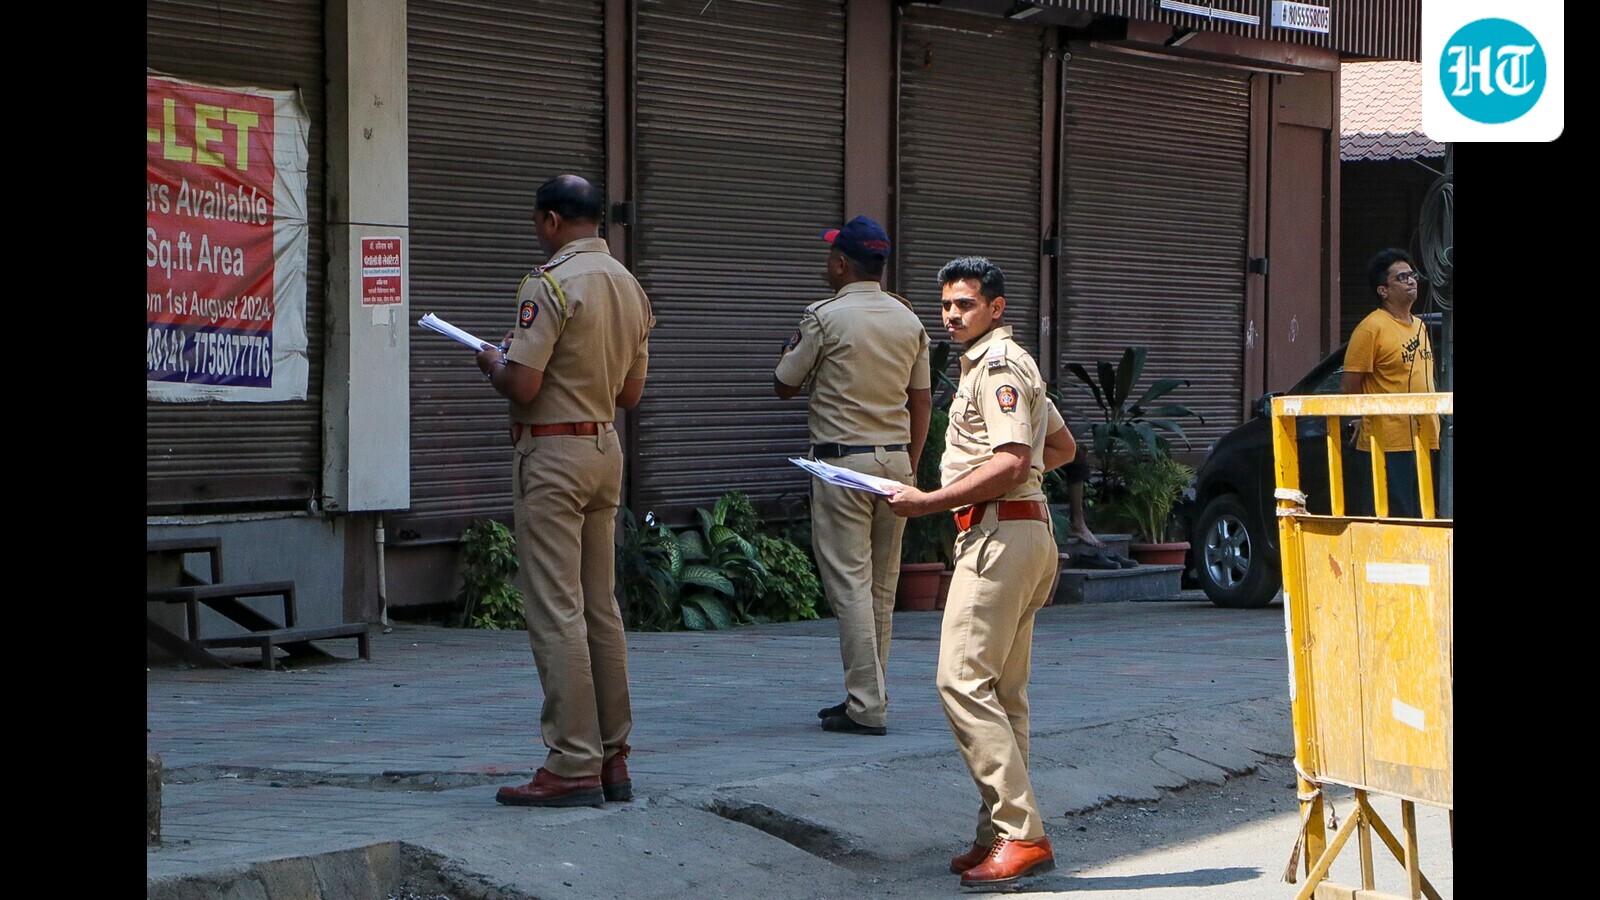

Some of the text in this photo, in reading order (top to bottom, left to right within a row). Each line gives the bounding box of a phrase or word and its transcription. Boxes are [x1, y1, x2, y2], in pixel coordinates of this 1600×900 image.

[147, 177, 268, 226] rs Available
[147, 227, 245, 279] Sq.ft Area
[166, 288, 188, 316] 1st
[189, 291, 239, 324] August
[240, 295, 271, 321] 2024
[193, 331, 271, 378] 7756077776
